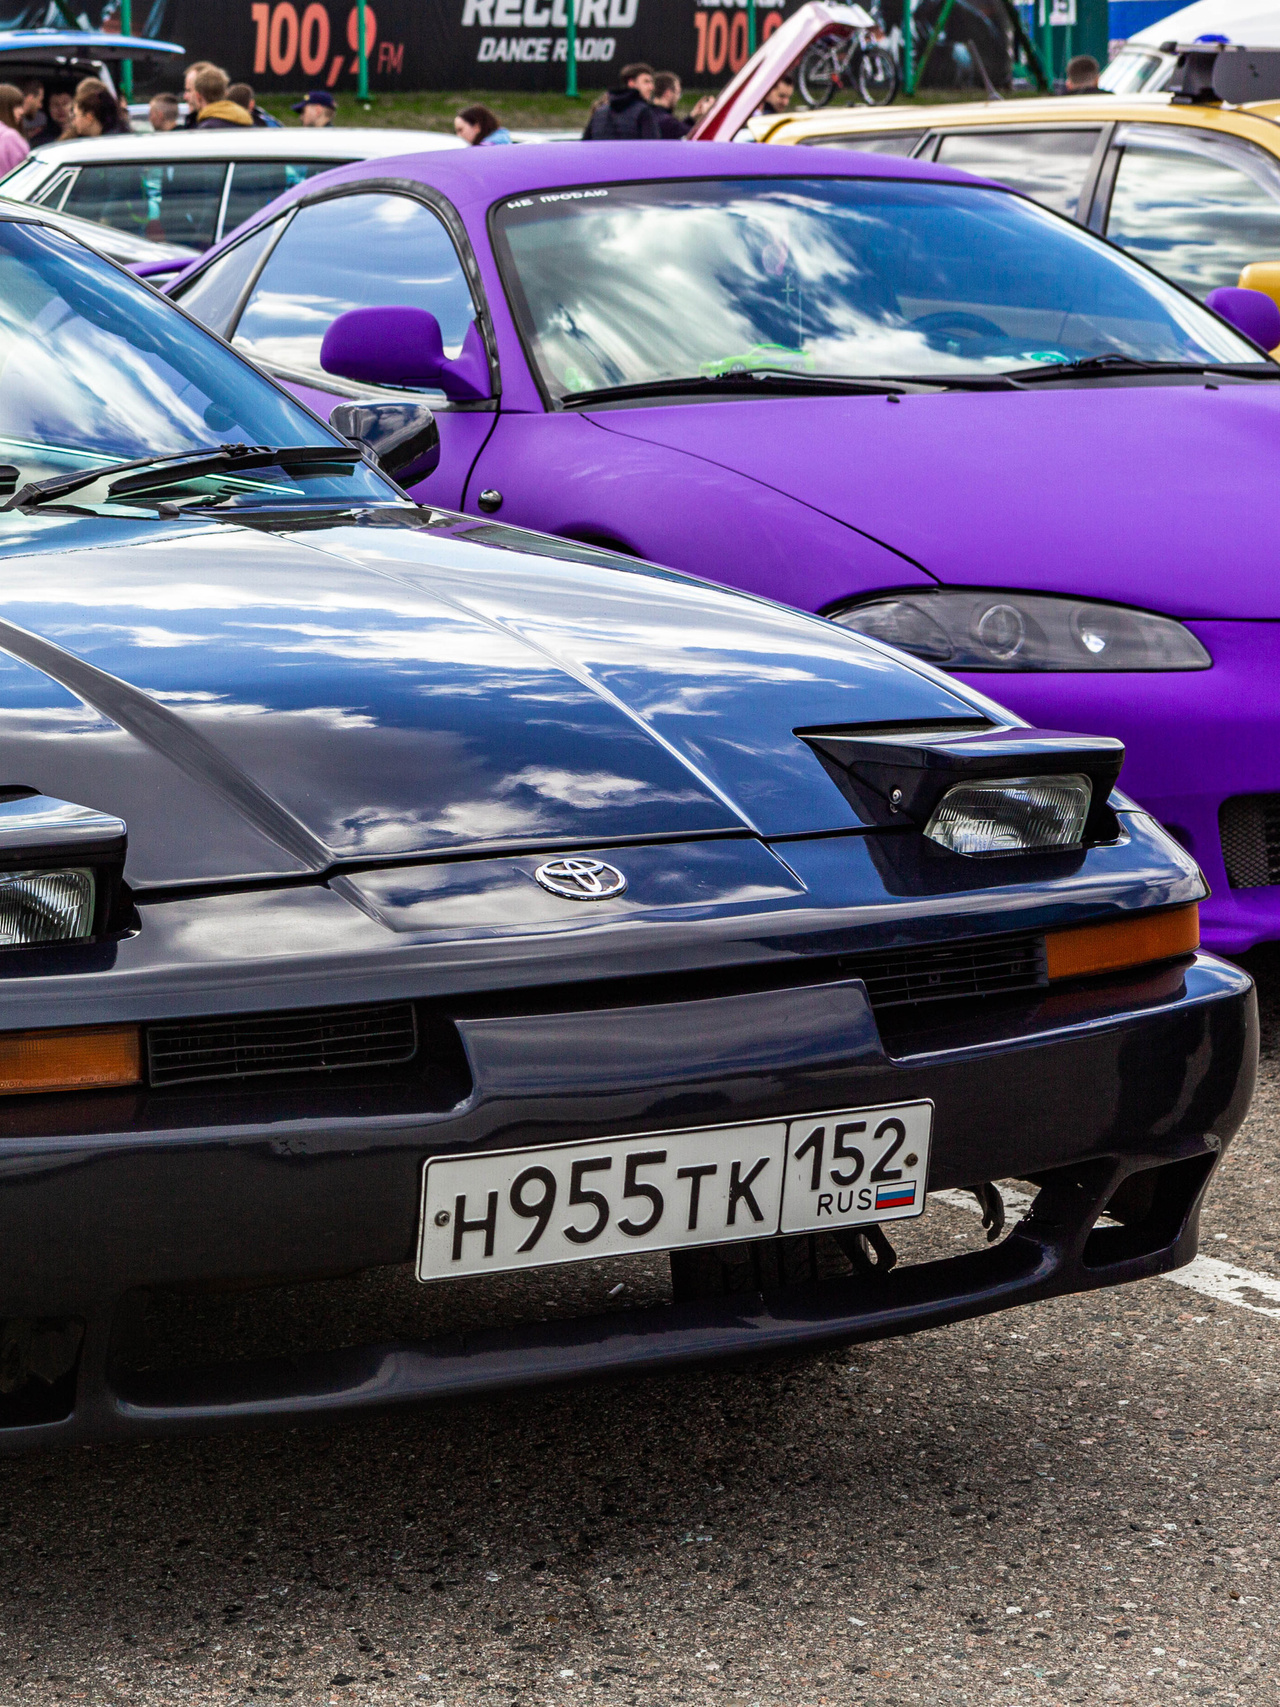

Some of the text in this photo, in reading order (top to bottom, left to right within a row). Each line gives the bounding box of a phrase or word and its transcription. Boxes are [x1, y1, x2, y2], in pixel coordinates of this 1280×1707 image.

[251, 1, 404, 87] 100,9 FM
[477, 37, 552, 62] DANCE
[793, 1116, 907, 1192] 152
[816, 1188, 872, 1217] RUS
